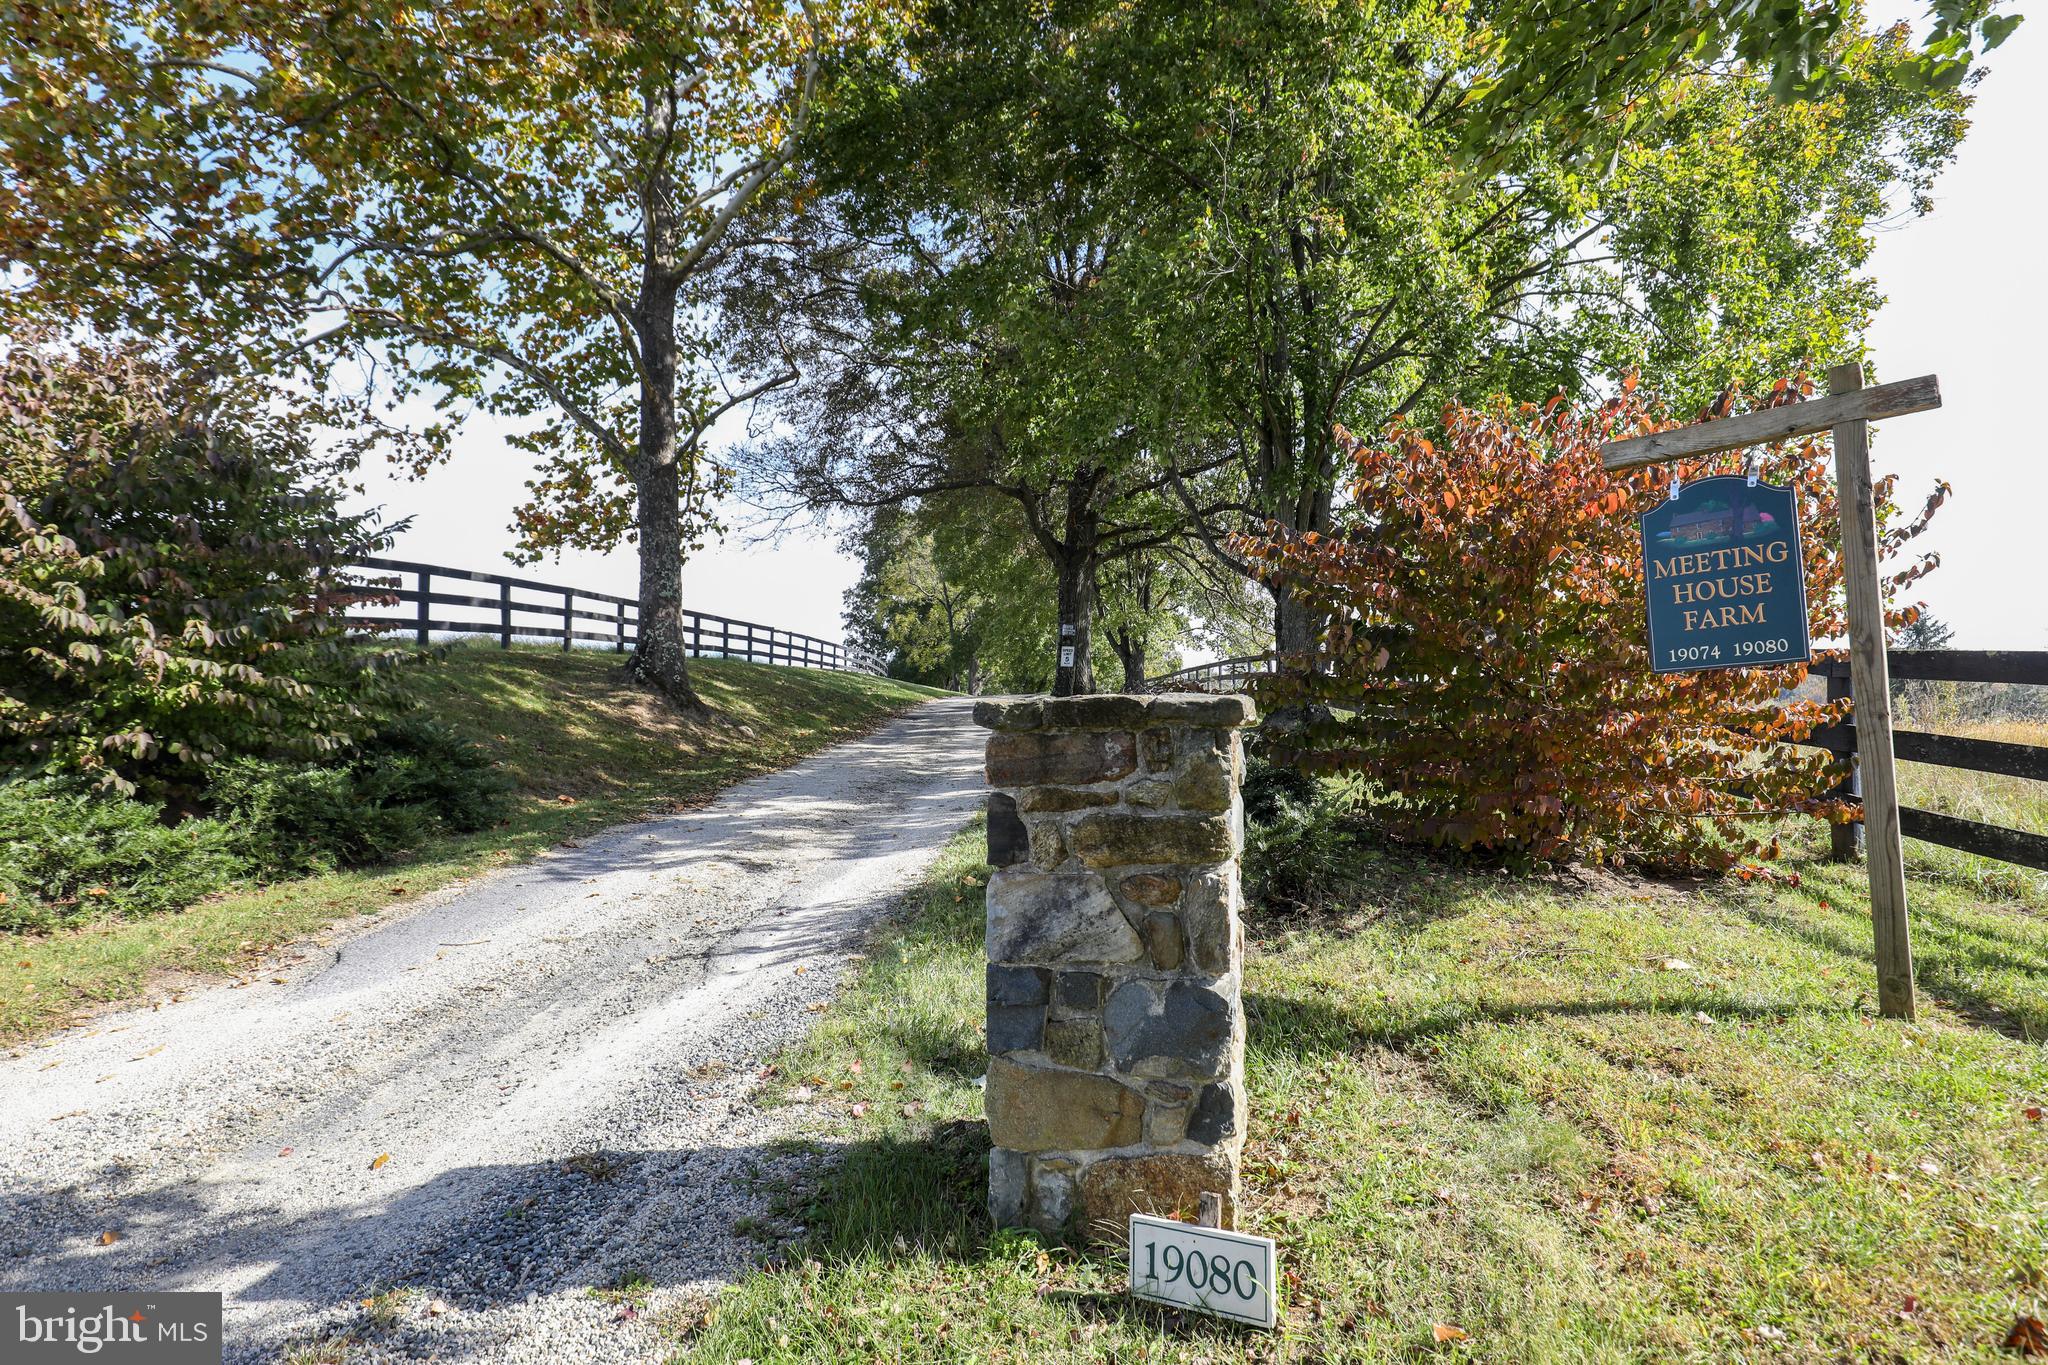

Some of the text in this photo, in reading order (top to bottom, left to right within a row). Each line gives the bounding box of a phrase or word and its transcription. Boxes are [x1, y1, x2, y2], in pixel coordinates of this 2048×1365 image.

[1653, 541, 1789, 580] MEETING
[1672, 572, 1773, 605] HOUSE
[1683, 603, 1768, 632] FARM
[1669, 638, 1789, 663] 19074 19080
[1145, 1241, 1257, 1301] 19080
